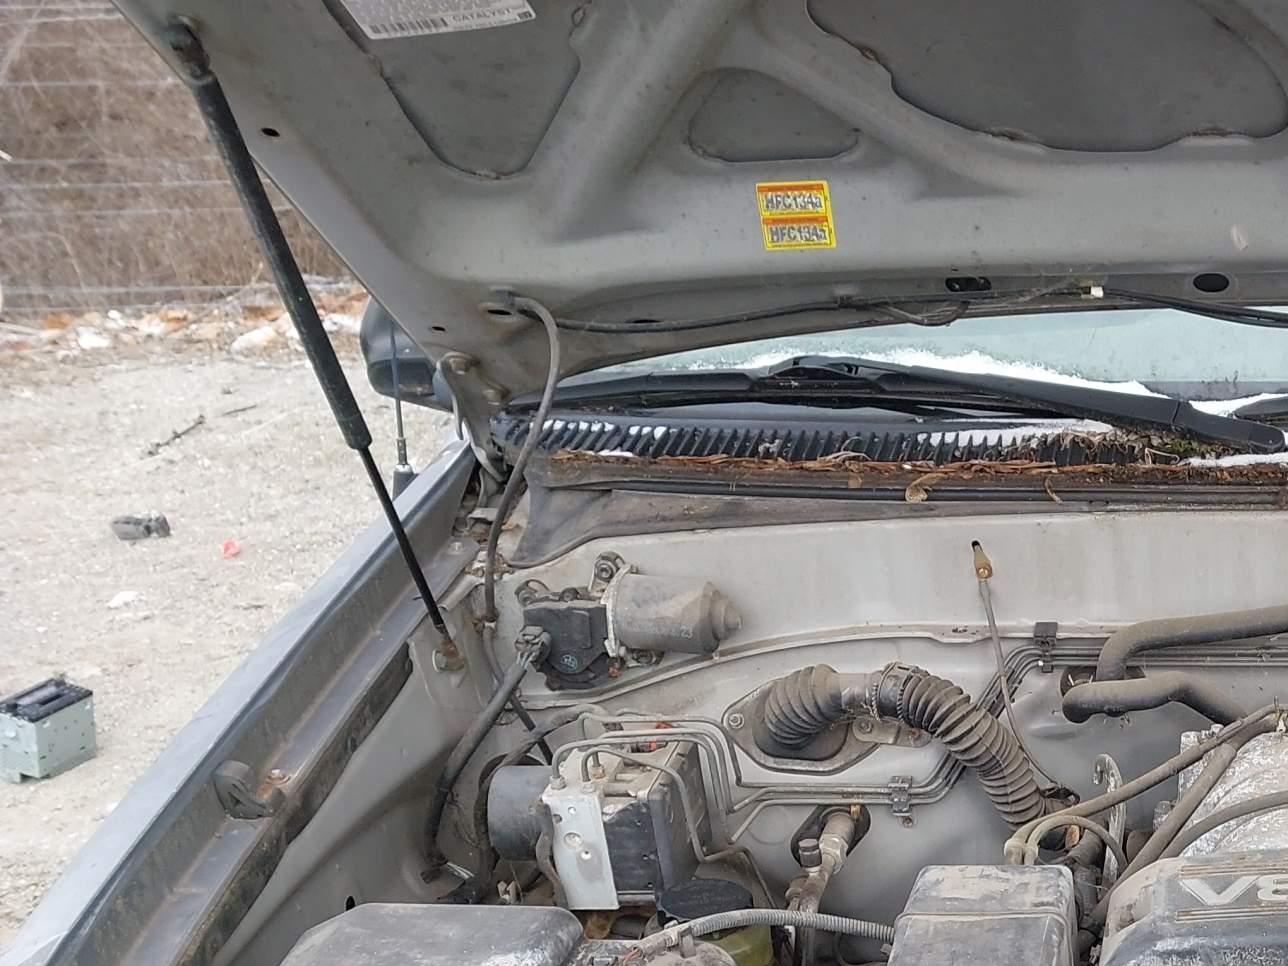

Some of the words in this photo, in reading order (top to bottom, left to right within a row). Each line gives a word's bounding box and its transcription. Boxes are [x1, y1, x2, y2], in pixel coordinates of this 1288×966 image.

[452, 8, 512, 22] CATALYST
[764, 192, 823, 210] HFC134a
[769, 225, 828, 243] HFC134a
